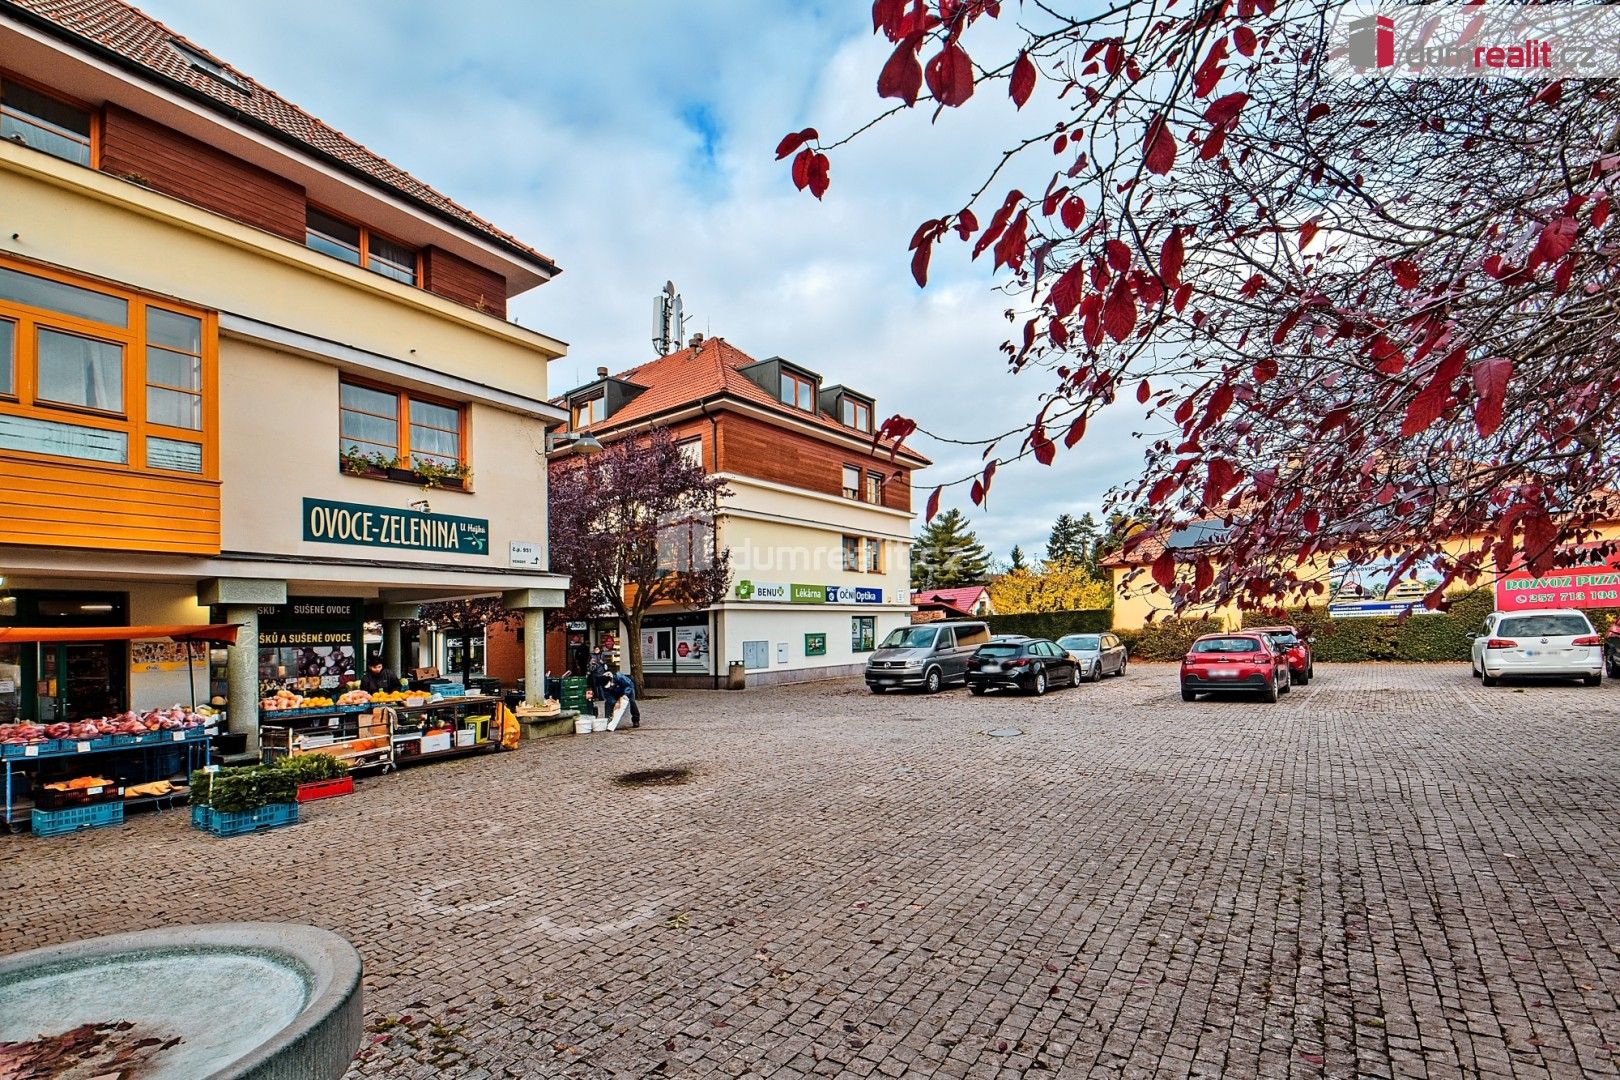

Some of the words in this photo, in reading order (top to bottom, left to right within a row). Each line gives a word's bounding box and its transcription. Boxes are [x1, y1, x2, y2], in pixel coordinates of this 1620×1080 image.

[310, 506, 459, 549] OVOCE-ZELENINA
[1505, 576, 1572, 591] ROZVOZ
[757, 587, 777, 597] BENU
[795, 588, 821, 599] Lékárna
[1529, 592, 1556, 603] 257
[1590, 590, 1618, 600] 198
[326, 605, 351, 614] OVOCE
[259, 631, 278, 644] ŠKŮ
[280, 634, 287, 643] A
[289, 631, 323, 643] SUŠENÉ
[324, 633, 351, 643] OVOCE
